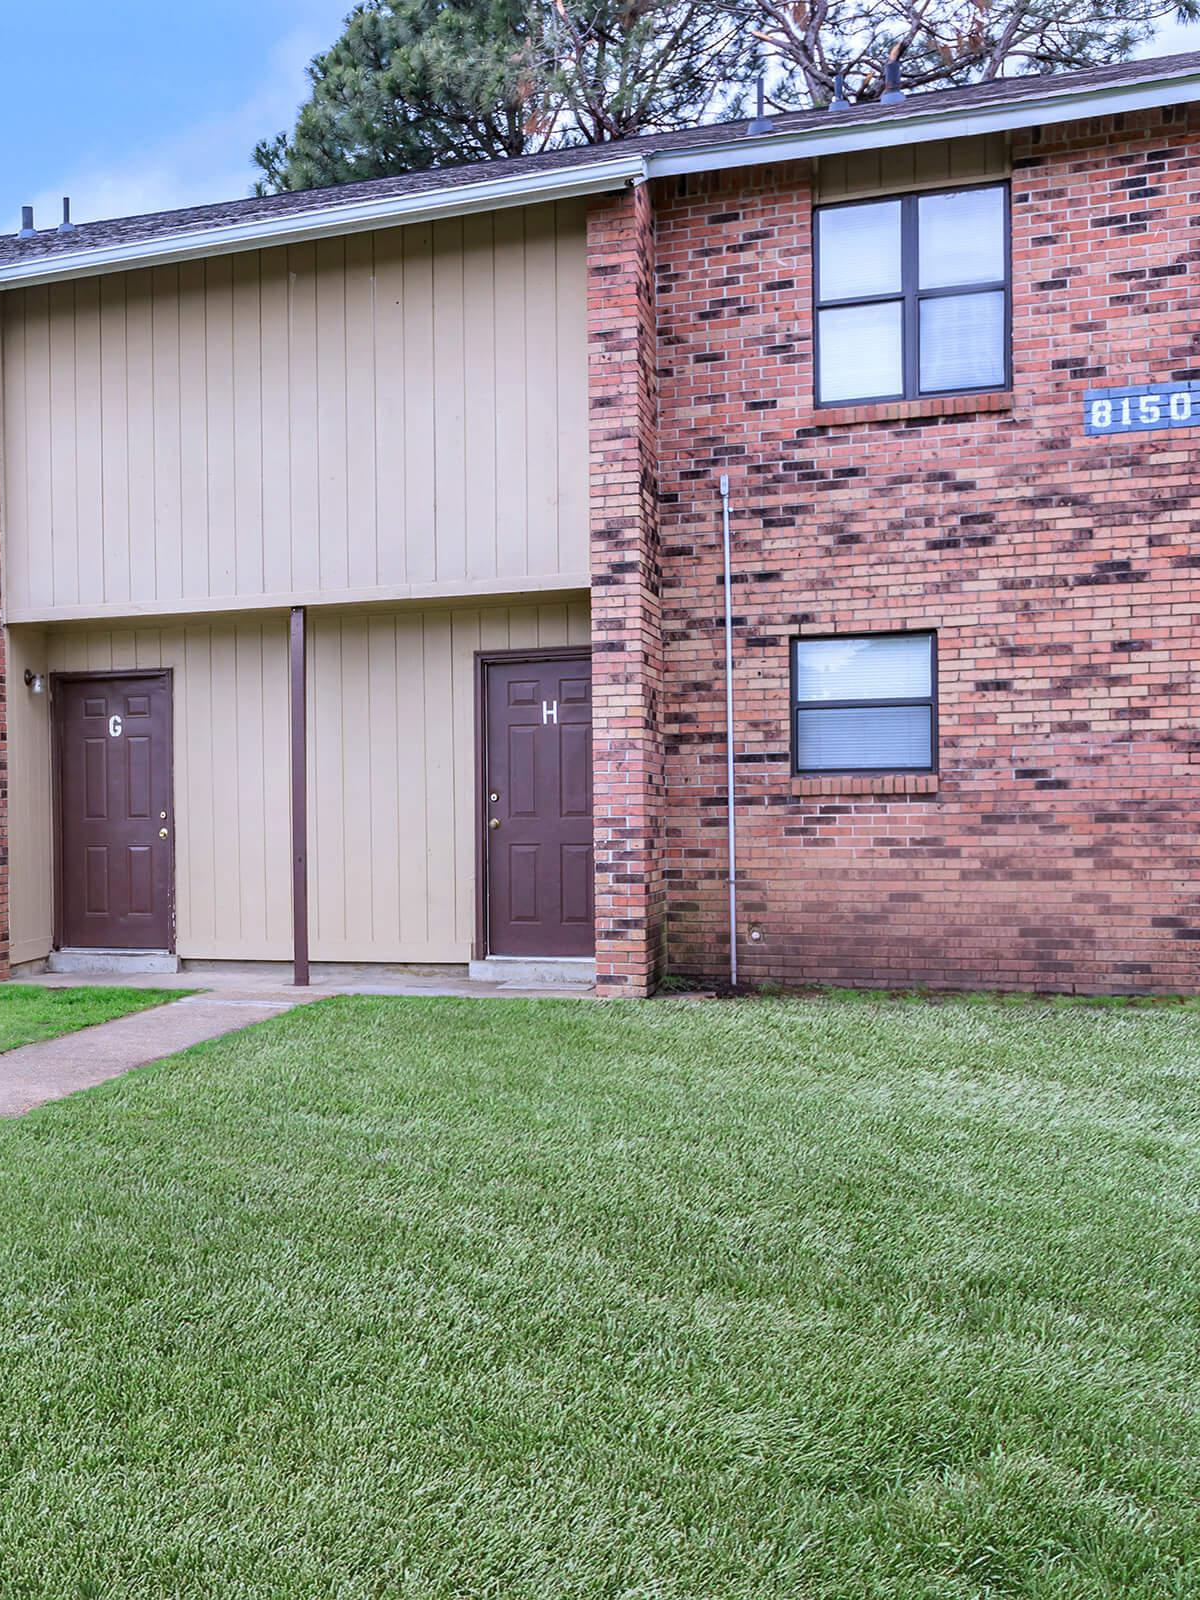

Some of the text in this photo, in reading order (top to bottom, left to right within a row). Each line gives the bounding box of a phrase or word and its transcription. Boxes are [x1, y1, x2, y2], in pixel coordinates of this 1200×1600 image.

[1091, 392, 1192, 428] 8150
[542, 700, 557, 725] H
[109, 714, 122, 737] G
